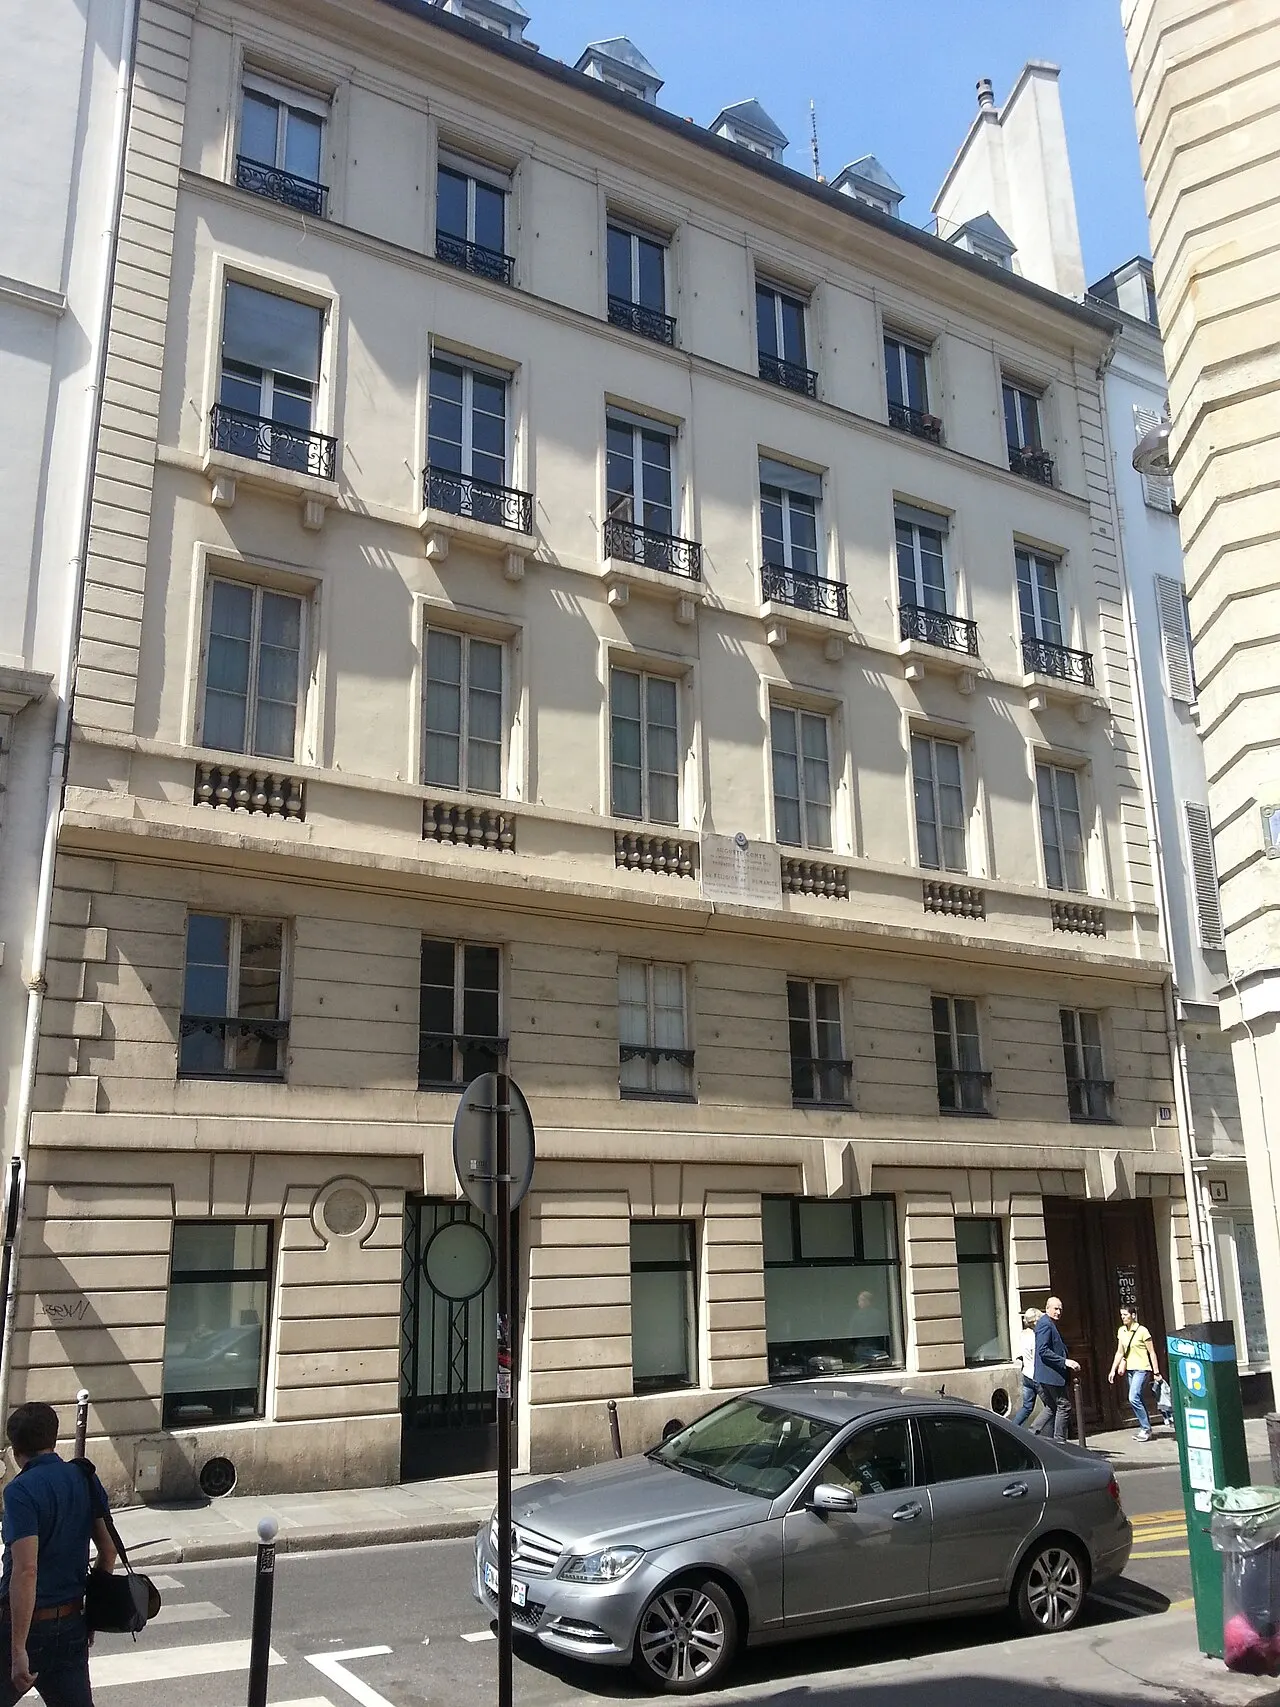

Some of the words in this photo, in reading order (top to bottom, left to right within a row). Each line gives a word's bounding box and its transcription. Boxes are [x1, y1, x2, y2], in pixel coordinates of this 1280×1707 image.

[746, 851, 766, 860] COMTE
[1161, 1108, 1170, 1119] 10
[1184, 1361, 1202, 1390] P
